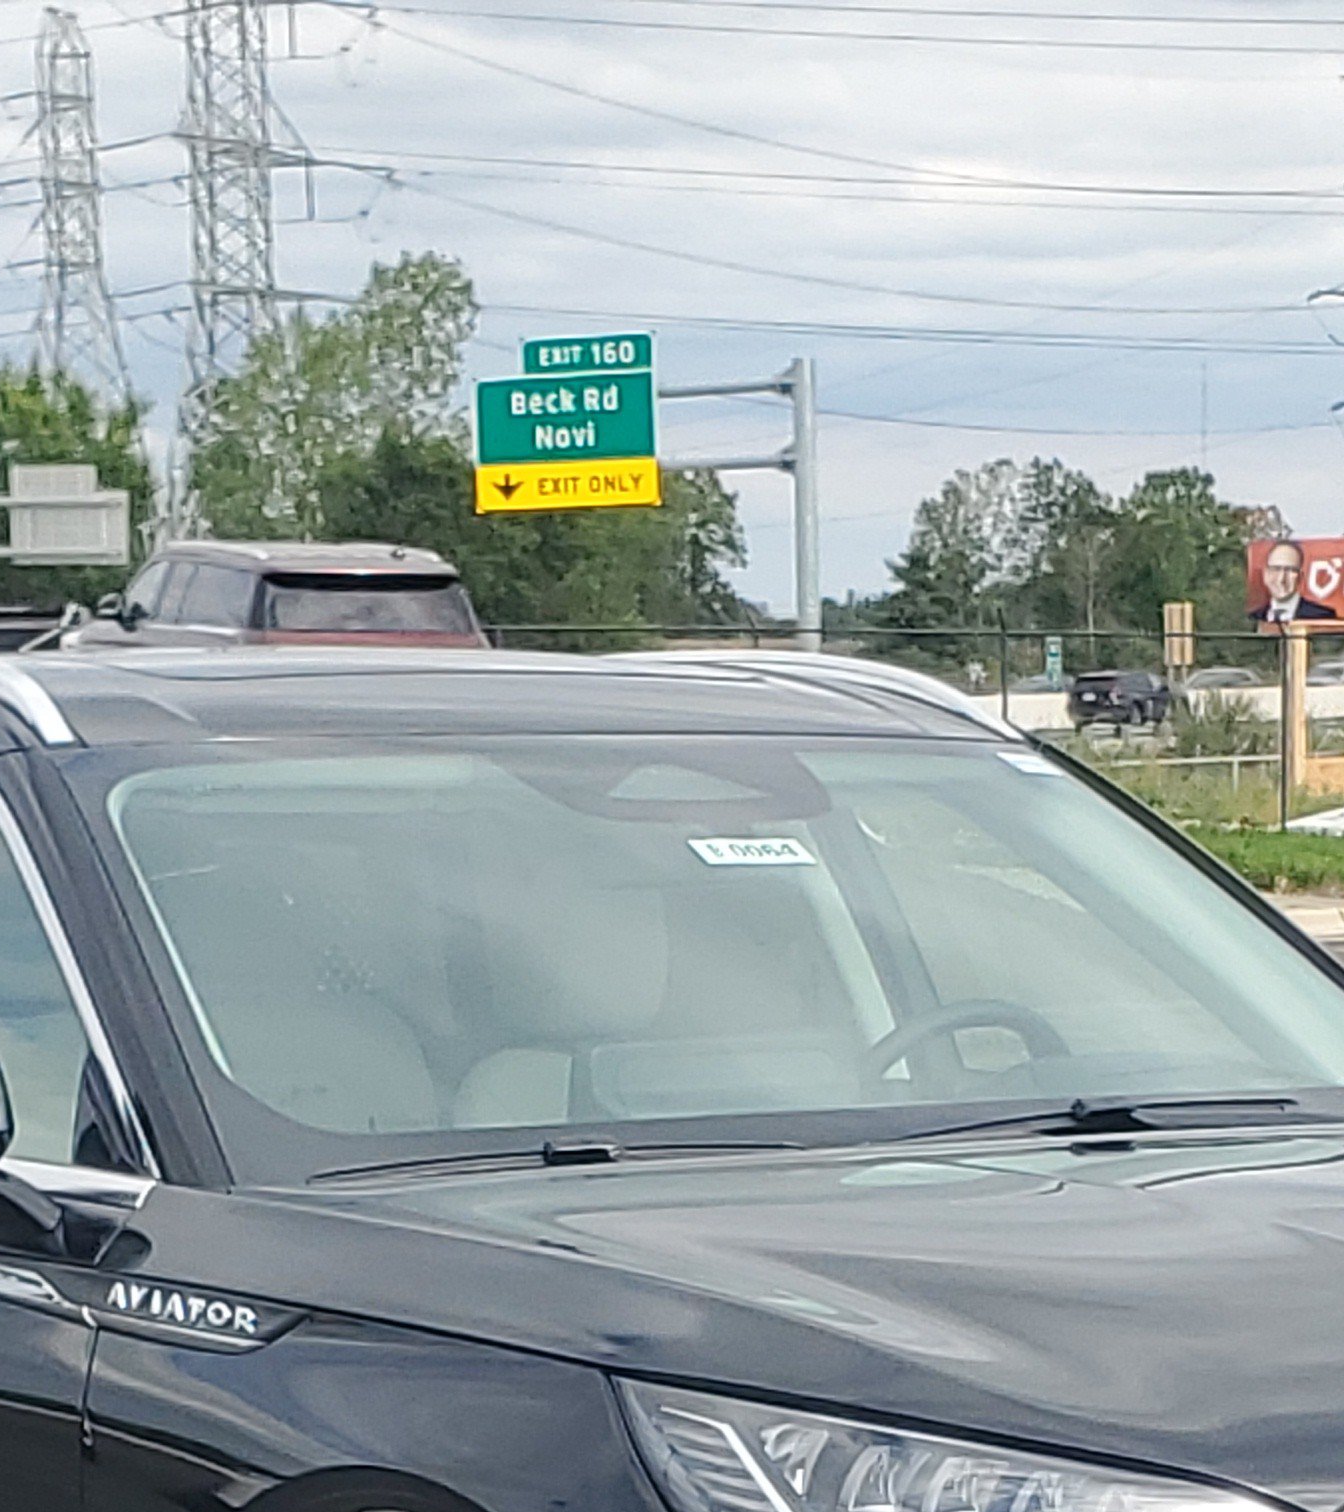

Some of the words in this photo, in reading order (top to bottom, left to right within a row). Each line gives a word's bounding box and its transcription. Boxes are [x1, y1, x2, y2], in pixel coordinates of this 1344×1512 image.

[539, 345, 582, 367] EXIT
[591, 341, 635, 365] 160
[511, 387, 576, 415] Beck
[583, 384, 618, 411] Rd
[535, 421, 595, 449] Novi
[538, 477, 580, 496] EXIT
[589, 473, 643, 493] ONLY
[107, 1281, 256, 1334] AVIATOR
